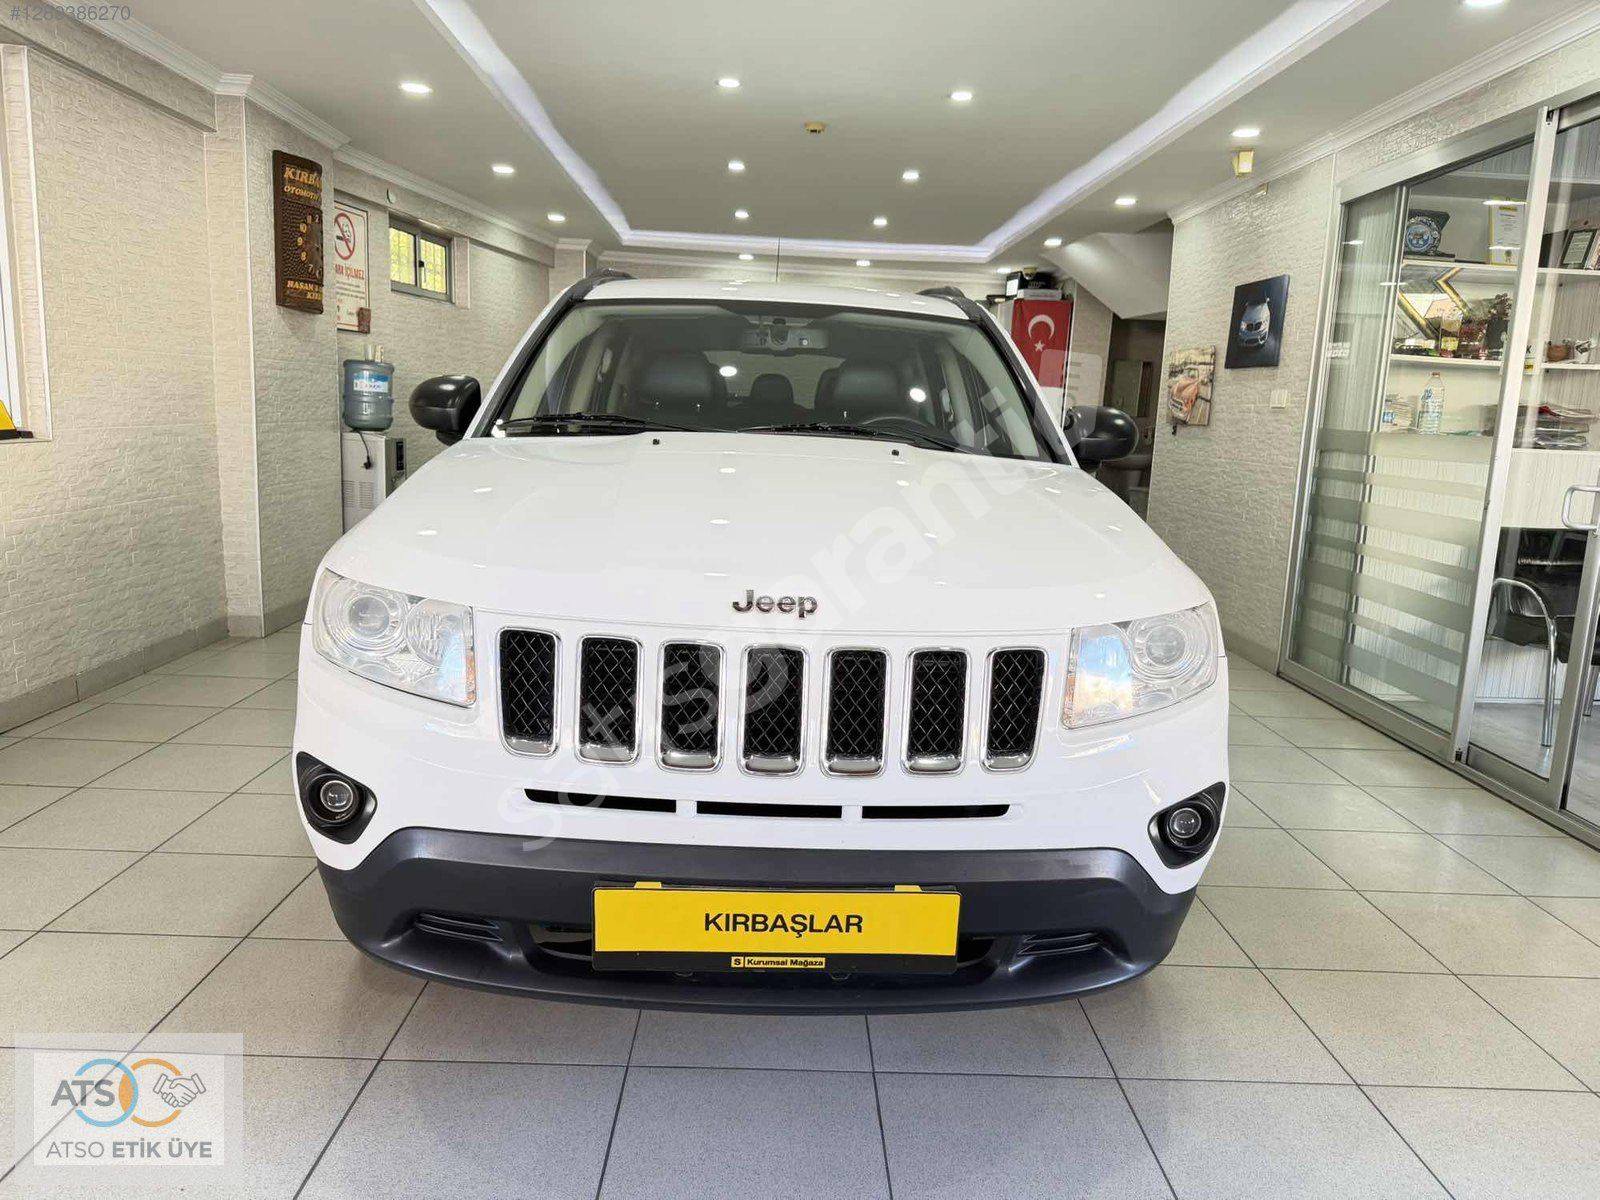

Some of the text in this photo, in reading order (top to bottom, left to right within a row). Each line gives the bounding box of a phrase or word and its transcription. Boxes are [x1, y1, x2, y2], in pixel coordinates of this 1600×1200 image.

[732, 589, 818, 618] Jeep
[704, 912, 864, 938] KIRBAŞLAR
[747, 958, 788, 966] Kurumsal
[790, 958, 823, 967] Mağaza
